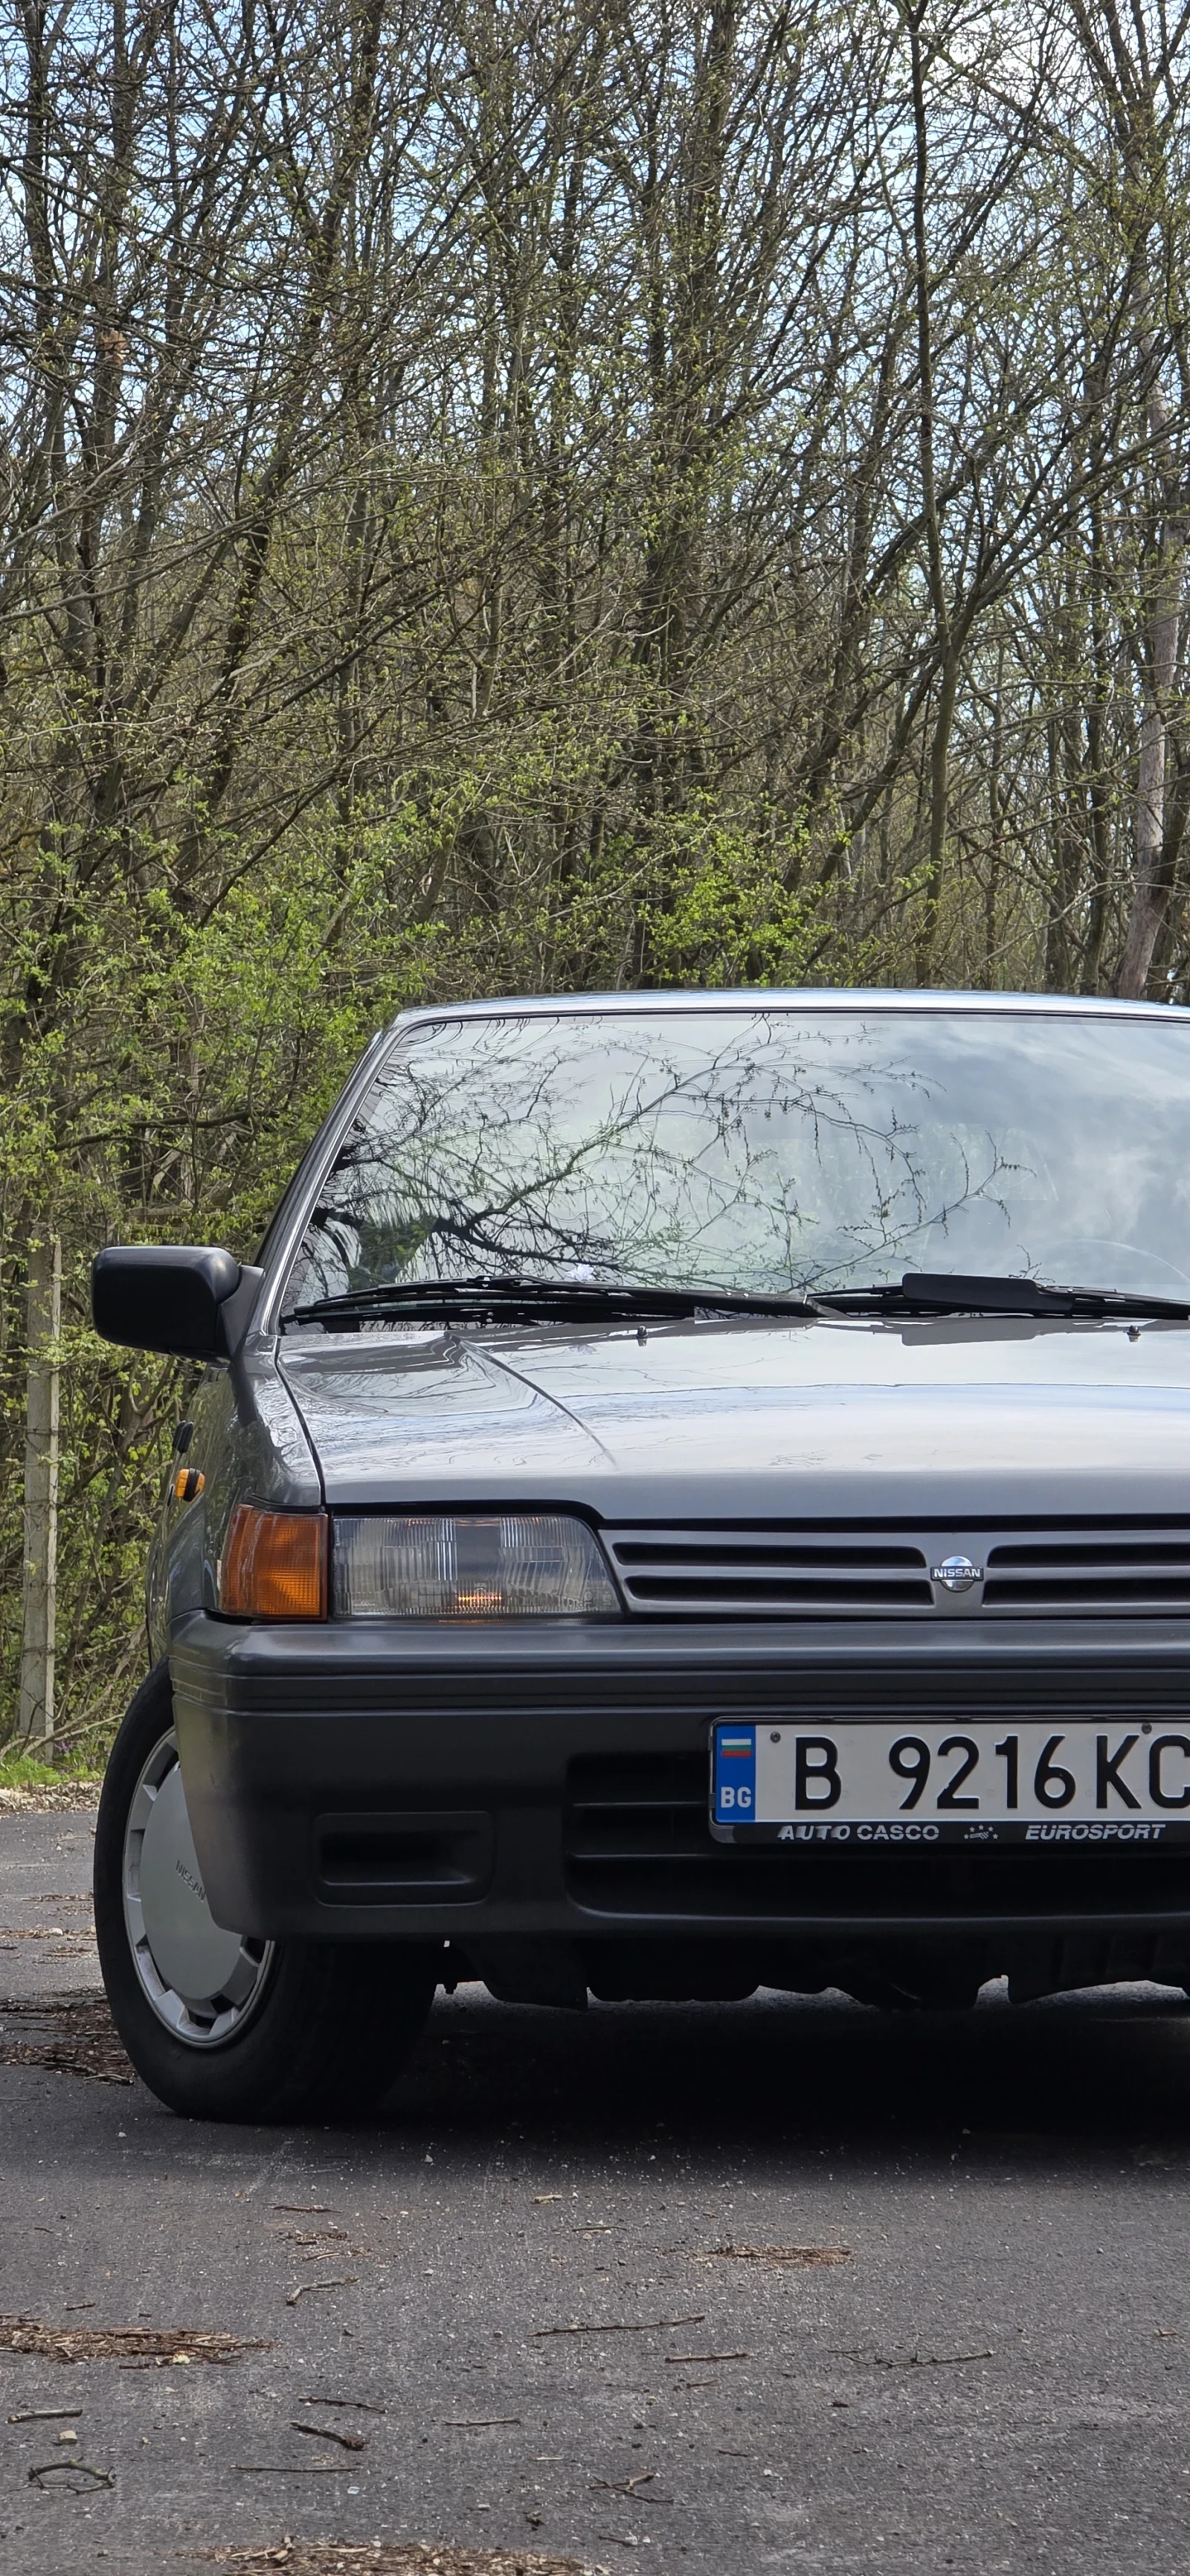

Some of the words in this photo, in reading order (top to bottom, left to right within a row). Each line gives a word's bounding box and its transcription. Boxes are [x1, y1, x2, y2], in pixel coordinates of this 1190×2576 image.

[933, 1568, 980, 1578] NISSAN
[794, 1736, 842, 1811] B
[721, 1787, 752, 1808] BG
[777, 1825, 851, 1840] AUTO
[856, 1825, 939, 1840] CASCO
[1025, 1824, 1166, 1840] EUROSPORT
[175, 1860, 207, 1903] NISSAN
